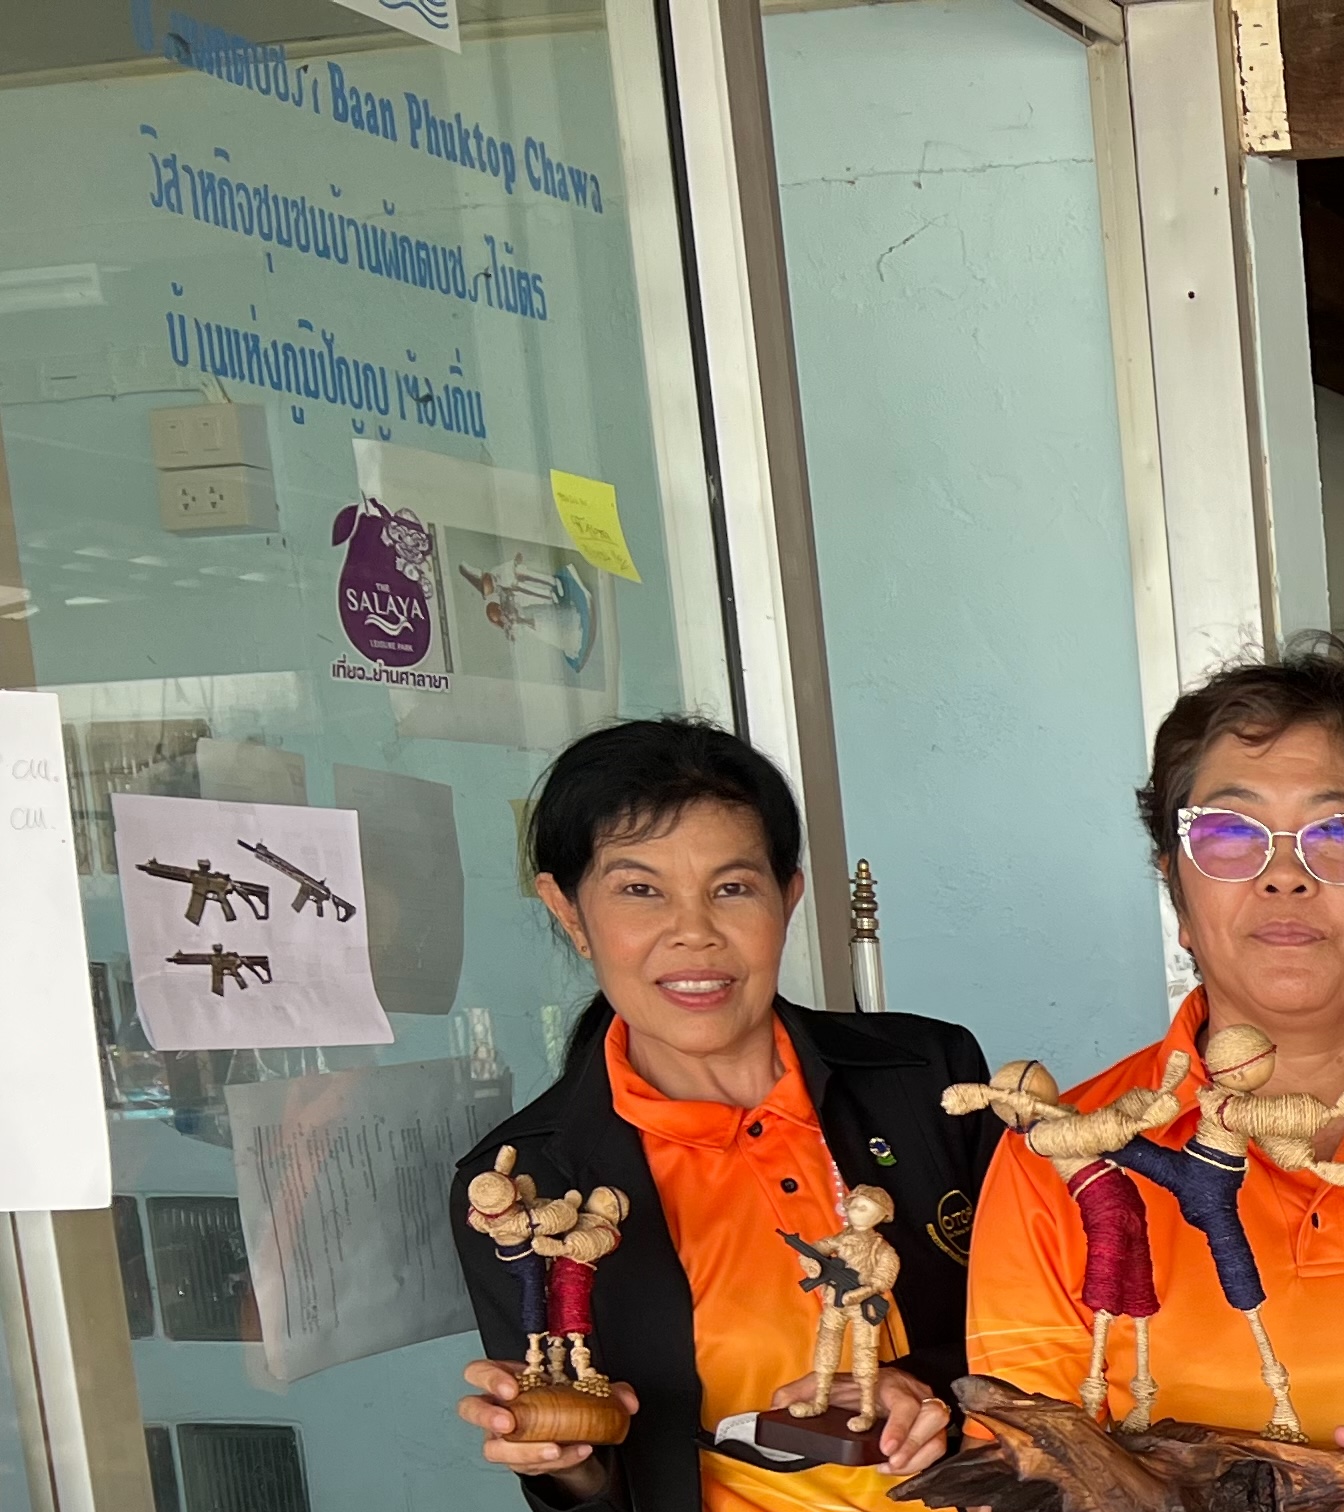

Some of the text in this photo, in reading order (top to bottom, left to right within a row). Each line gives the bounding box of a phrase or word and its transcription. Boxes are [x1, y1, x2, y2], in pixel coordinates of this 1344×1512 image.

[327, 61, 398, 142] Baan
[402, 91, 516, 195] Phuktop
[523, 136, 604, 214] Chawa
[346, 588, 425, 620] SALAYA
